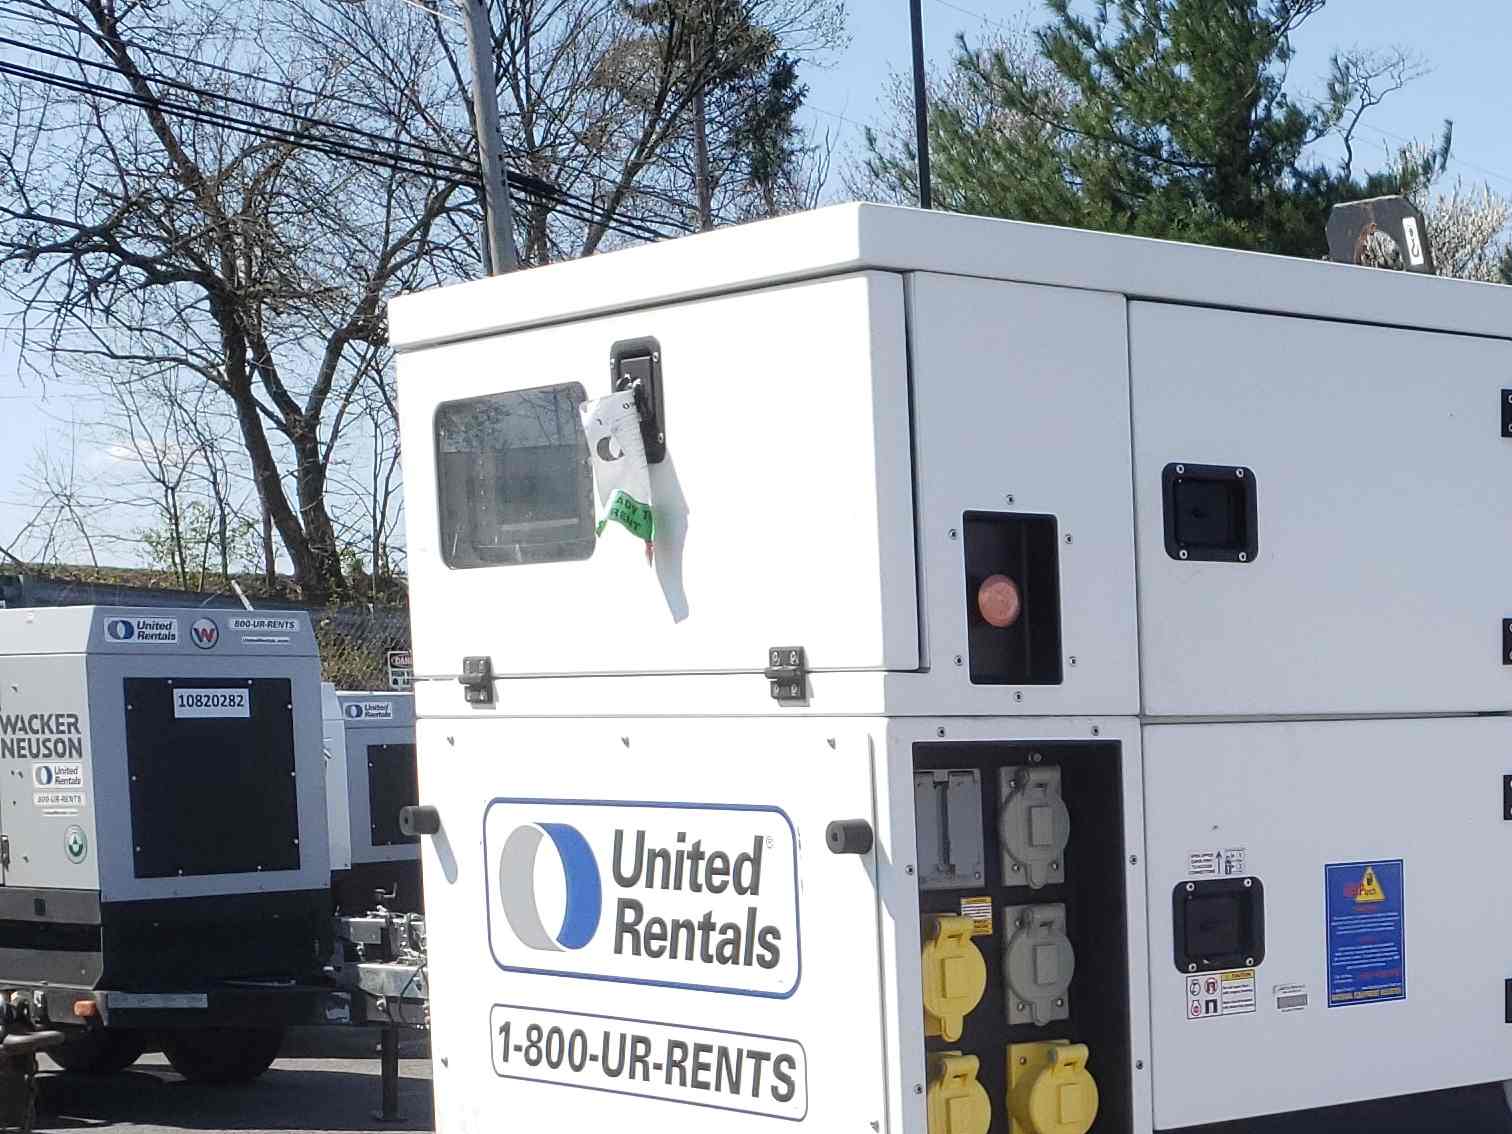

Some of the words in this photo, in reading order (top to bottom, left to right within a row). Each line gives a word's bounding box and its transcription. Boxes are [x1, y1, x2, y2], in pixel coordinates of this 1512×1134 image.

[137, 620, 173, 631] United
[137, 631, 177, 641] Rentals
[178, 694, 245, 708] 10820282
[0, 713, 82, 735] WACKER
[1, 737, 82, 759] NEUSON
[612, 829, 764, 896] United
[613, 897, 782, 970] Rentals
[498, 1021, 798, 1103] 1-800-UR-RENTS
